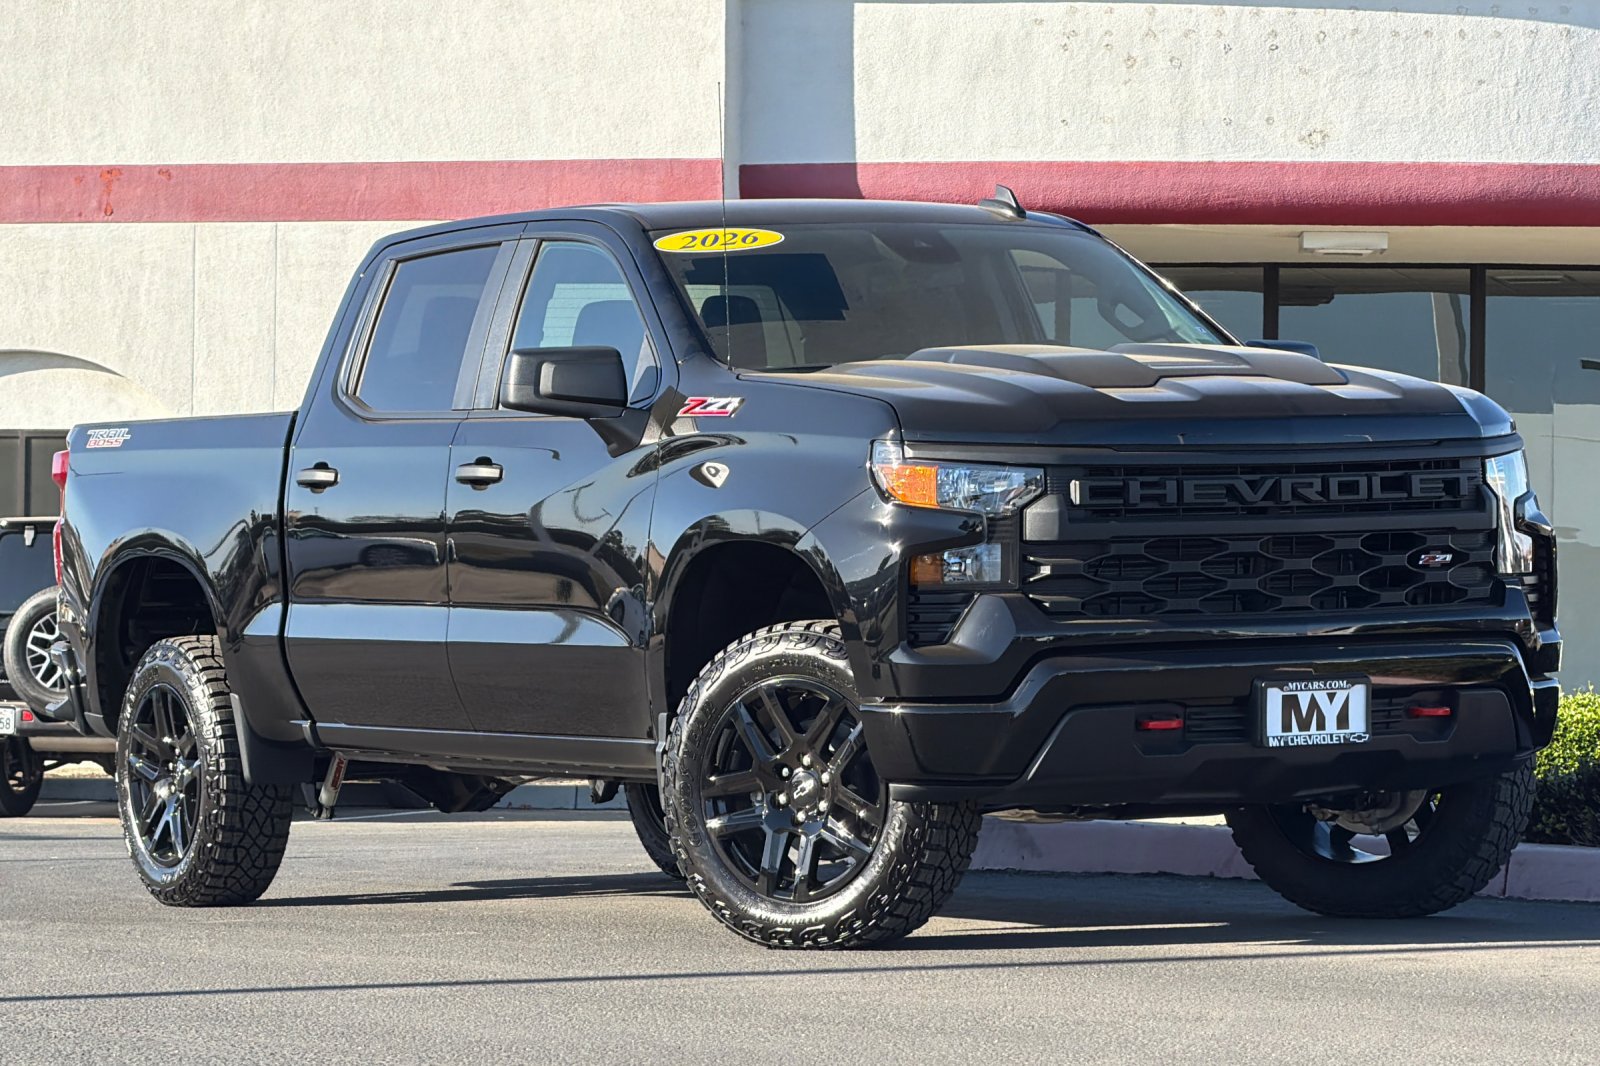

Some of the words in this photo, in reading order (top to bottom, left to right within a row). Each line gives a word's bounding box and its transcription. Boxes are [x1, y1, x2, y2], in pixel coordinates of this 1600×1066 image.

[679, 232, 759, 249] 2026
[676, 396, 745, 418] Z71
[87, 428, 131, 440] TRAIL
[86, 438, 124, 448] BOSS
[1070, 473, 1478, 506] CHEVROLET
[1419, 554, 1453, 565] Z71
[1287, 680, 1347, 691] MYCARS.COM
[1281, 692, 1350, 733] MY
[1269, 736, 1285, 748] MY
[1288, 733, 1345, 746] CHEVROLET
